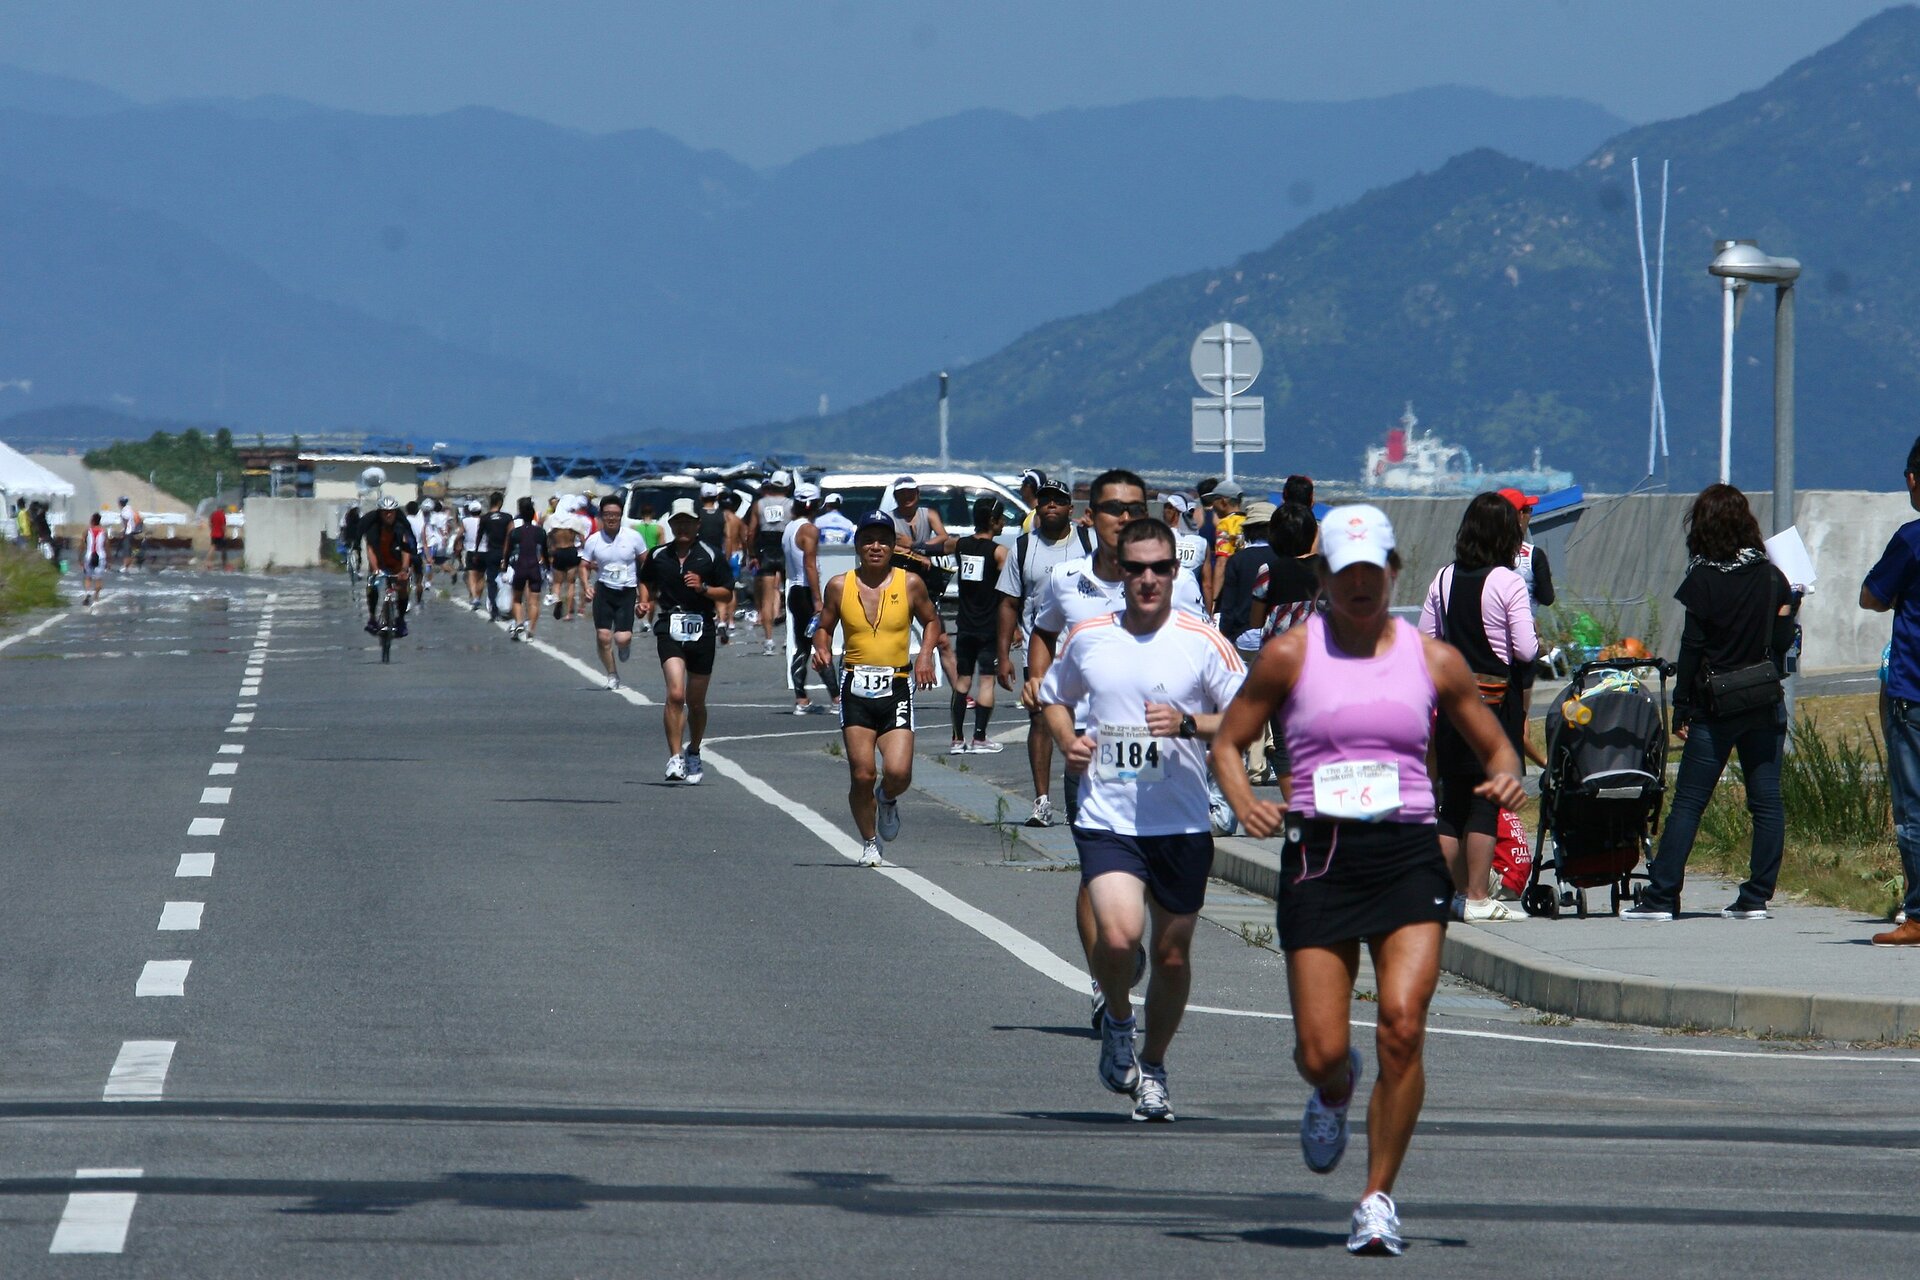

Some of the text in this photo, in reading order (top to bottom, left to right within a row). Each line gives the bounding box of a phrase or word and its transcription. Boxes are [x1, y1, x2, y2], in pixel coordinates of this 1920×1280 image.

[963, 562, 974, 574] 79
[681, 622, 701, 634] 100
[864, 675, 890, 690] 135
[1116, 741, 1159, 768] 184
